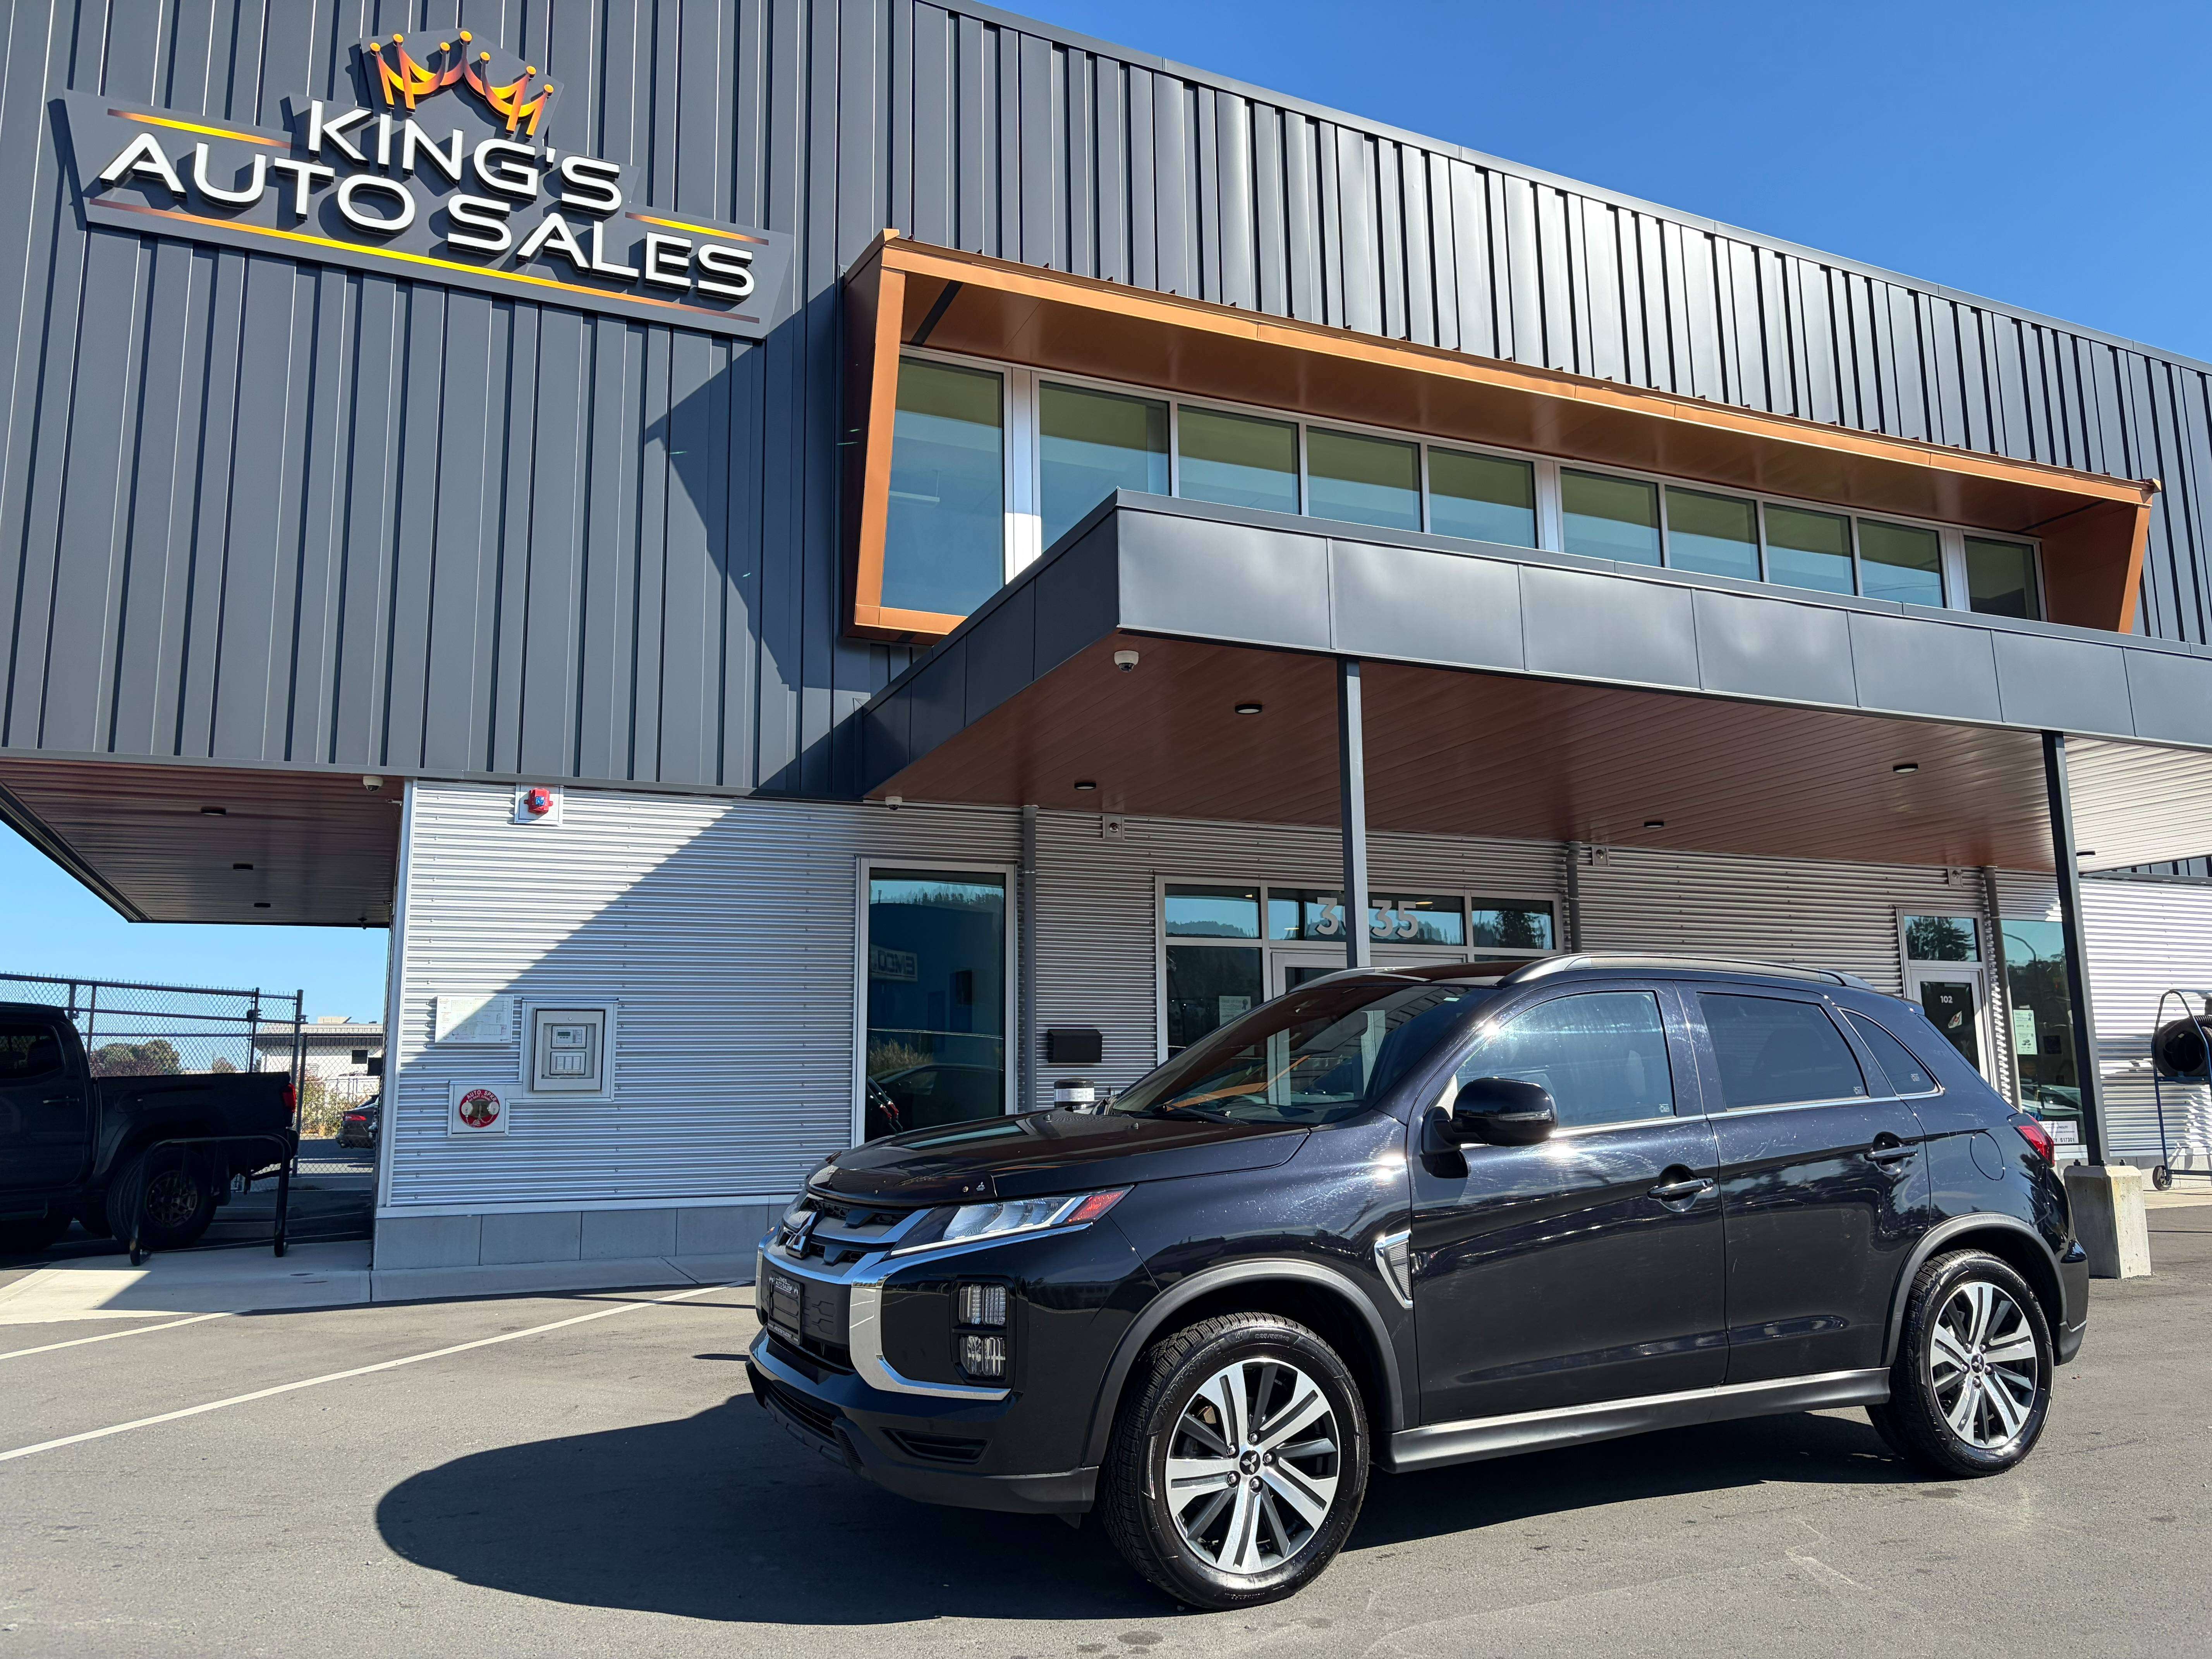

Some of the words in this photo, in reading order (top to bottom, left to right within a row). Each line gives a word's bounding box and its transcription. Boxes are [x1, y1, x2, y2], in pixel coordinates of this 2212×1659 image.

[309, 100, 622, 211] KING'S
[99, 132, 416, 232] AUTO
[448, 194, 755, 298] SALES
[1317, 896, 1418, 938] 335
[1940, 995, 1953, 1003] 102
